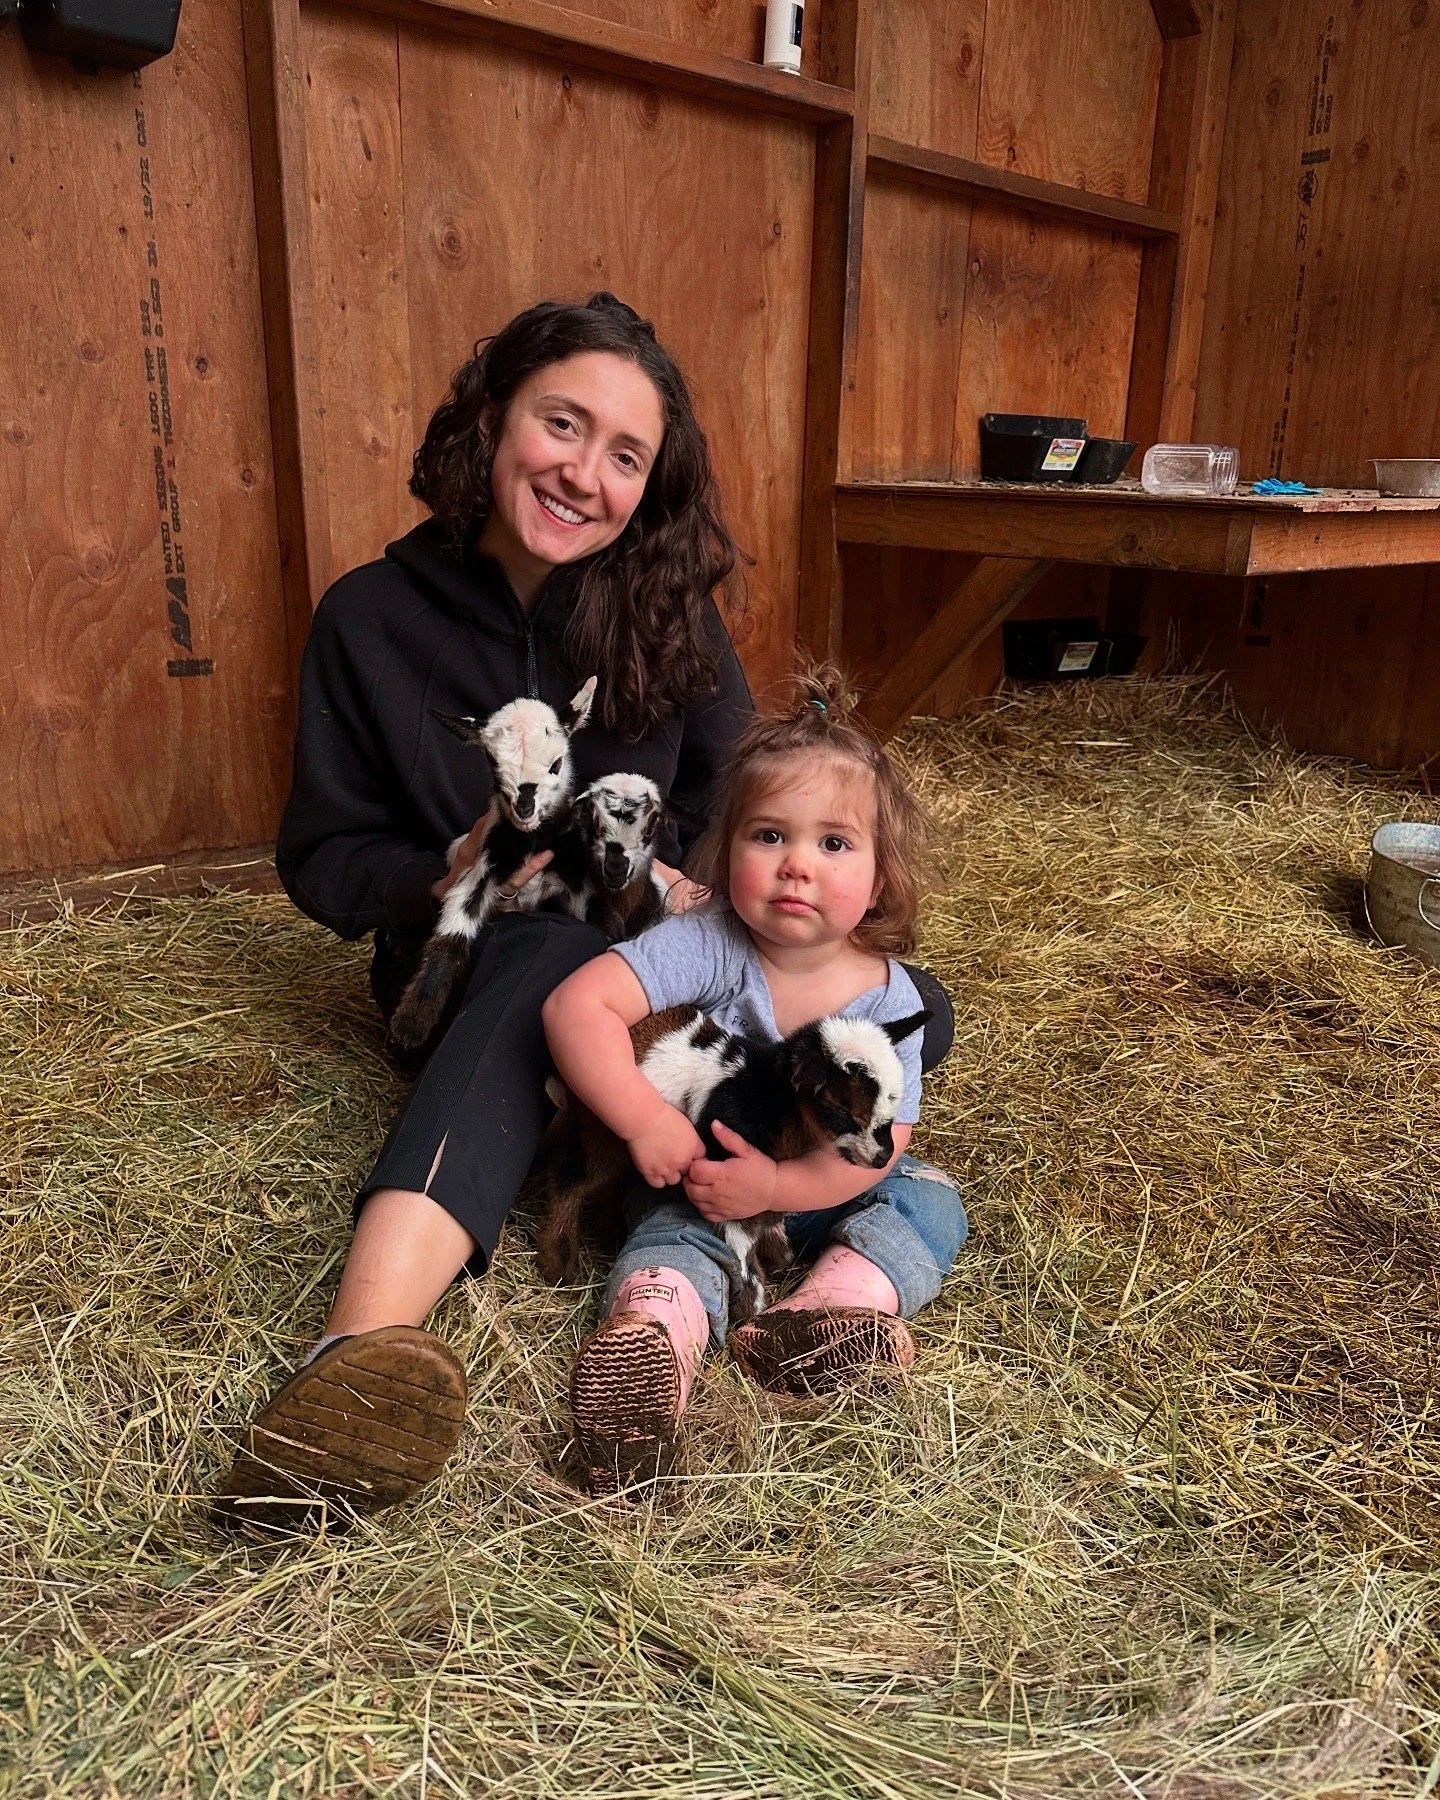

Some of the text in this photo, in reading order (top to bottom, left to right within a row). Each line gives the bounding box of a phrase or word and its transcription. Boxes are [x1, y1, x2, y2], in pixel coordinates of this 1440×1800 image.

[168, 479, 181, 533] GROUP
[161, 521, 173, 575] RATED
[174, 542, 185, 573] EXT
[166, 577, 192, 653] APA
[632, 1288, 670, 1297] HUNTER
